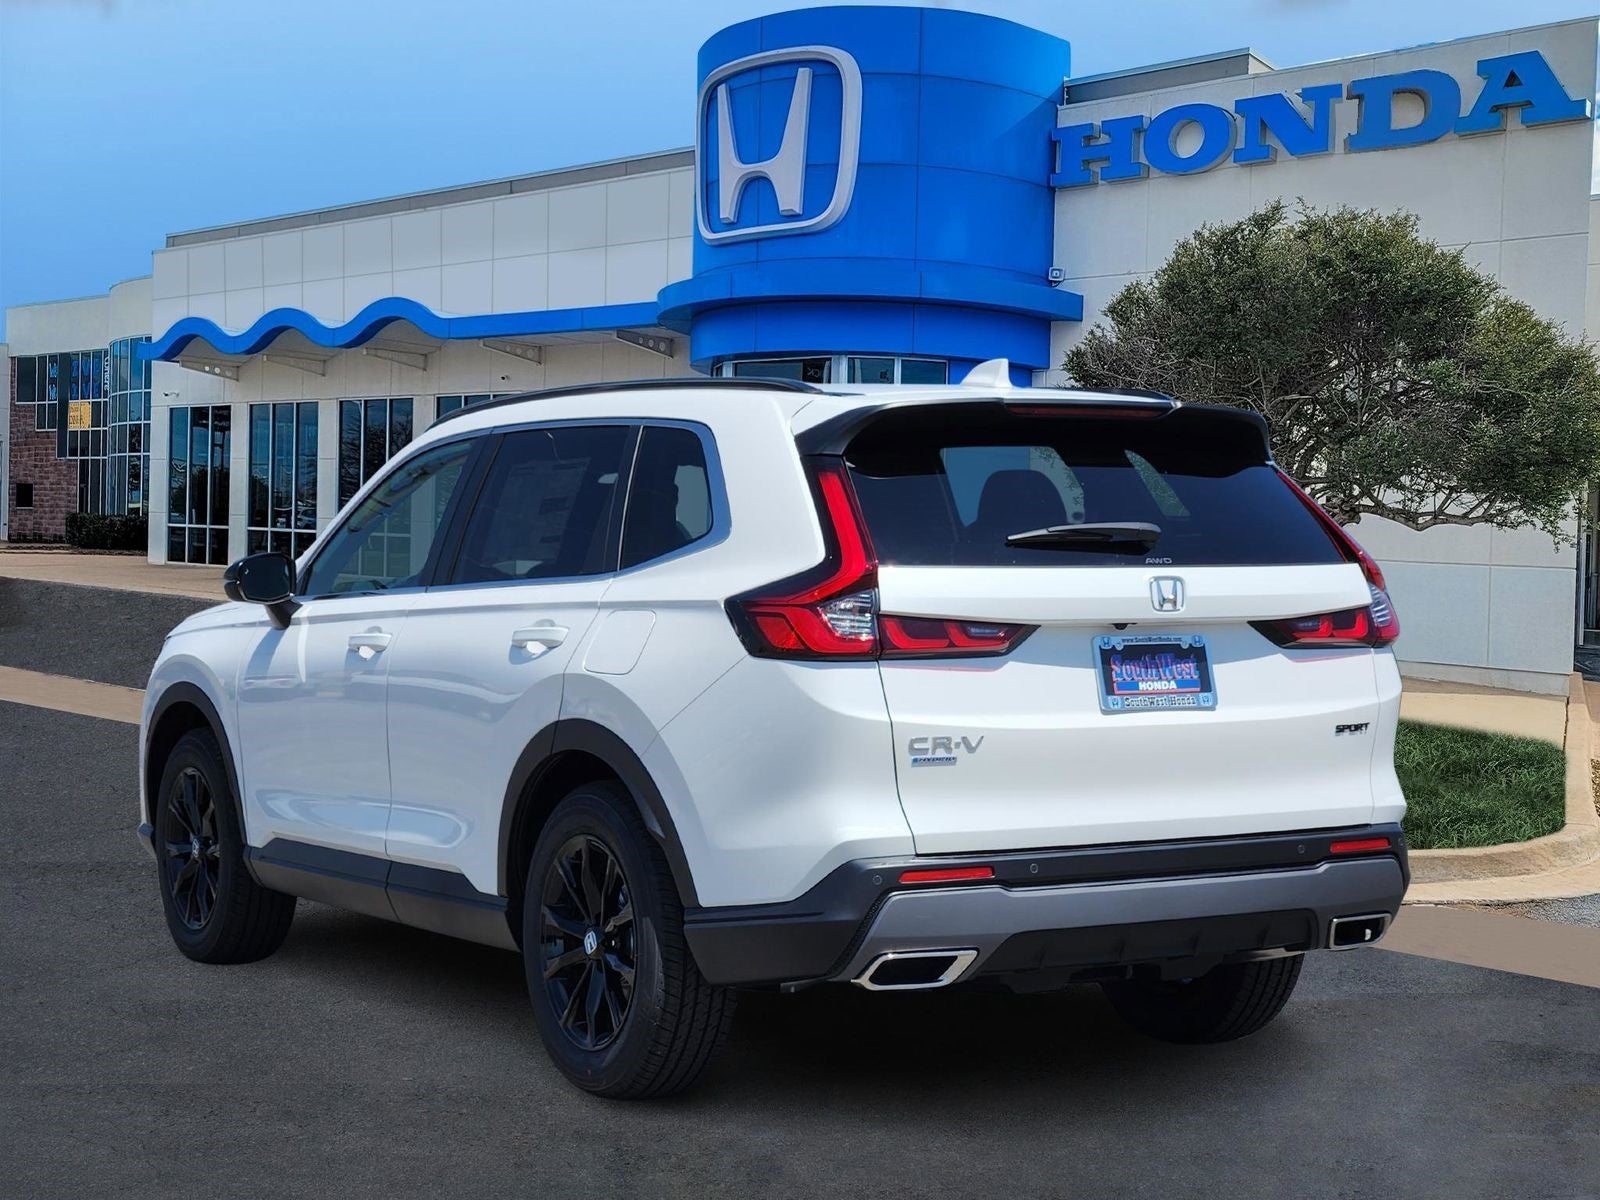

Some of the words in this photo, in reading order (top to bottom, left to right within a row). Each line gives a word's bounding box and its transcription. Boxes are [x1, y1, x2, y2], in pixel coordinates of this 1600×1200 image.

[1049, 50, 1591, 189] HONDA
[1111, 653, 1200, 681] SouthWest
[1138, 680, 1178, 691] HONDA
[1124, 696, 1168, 707] SouthWest
[1170, 695, 1197, 706] Honda
[1335, 722, 1370, 733] SPORT
[908, 735, 985, 756] CR-V
